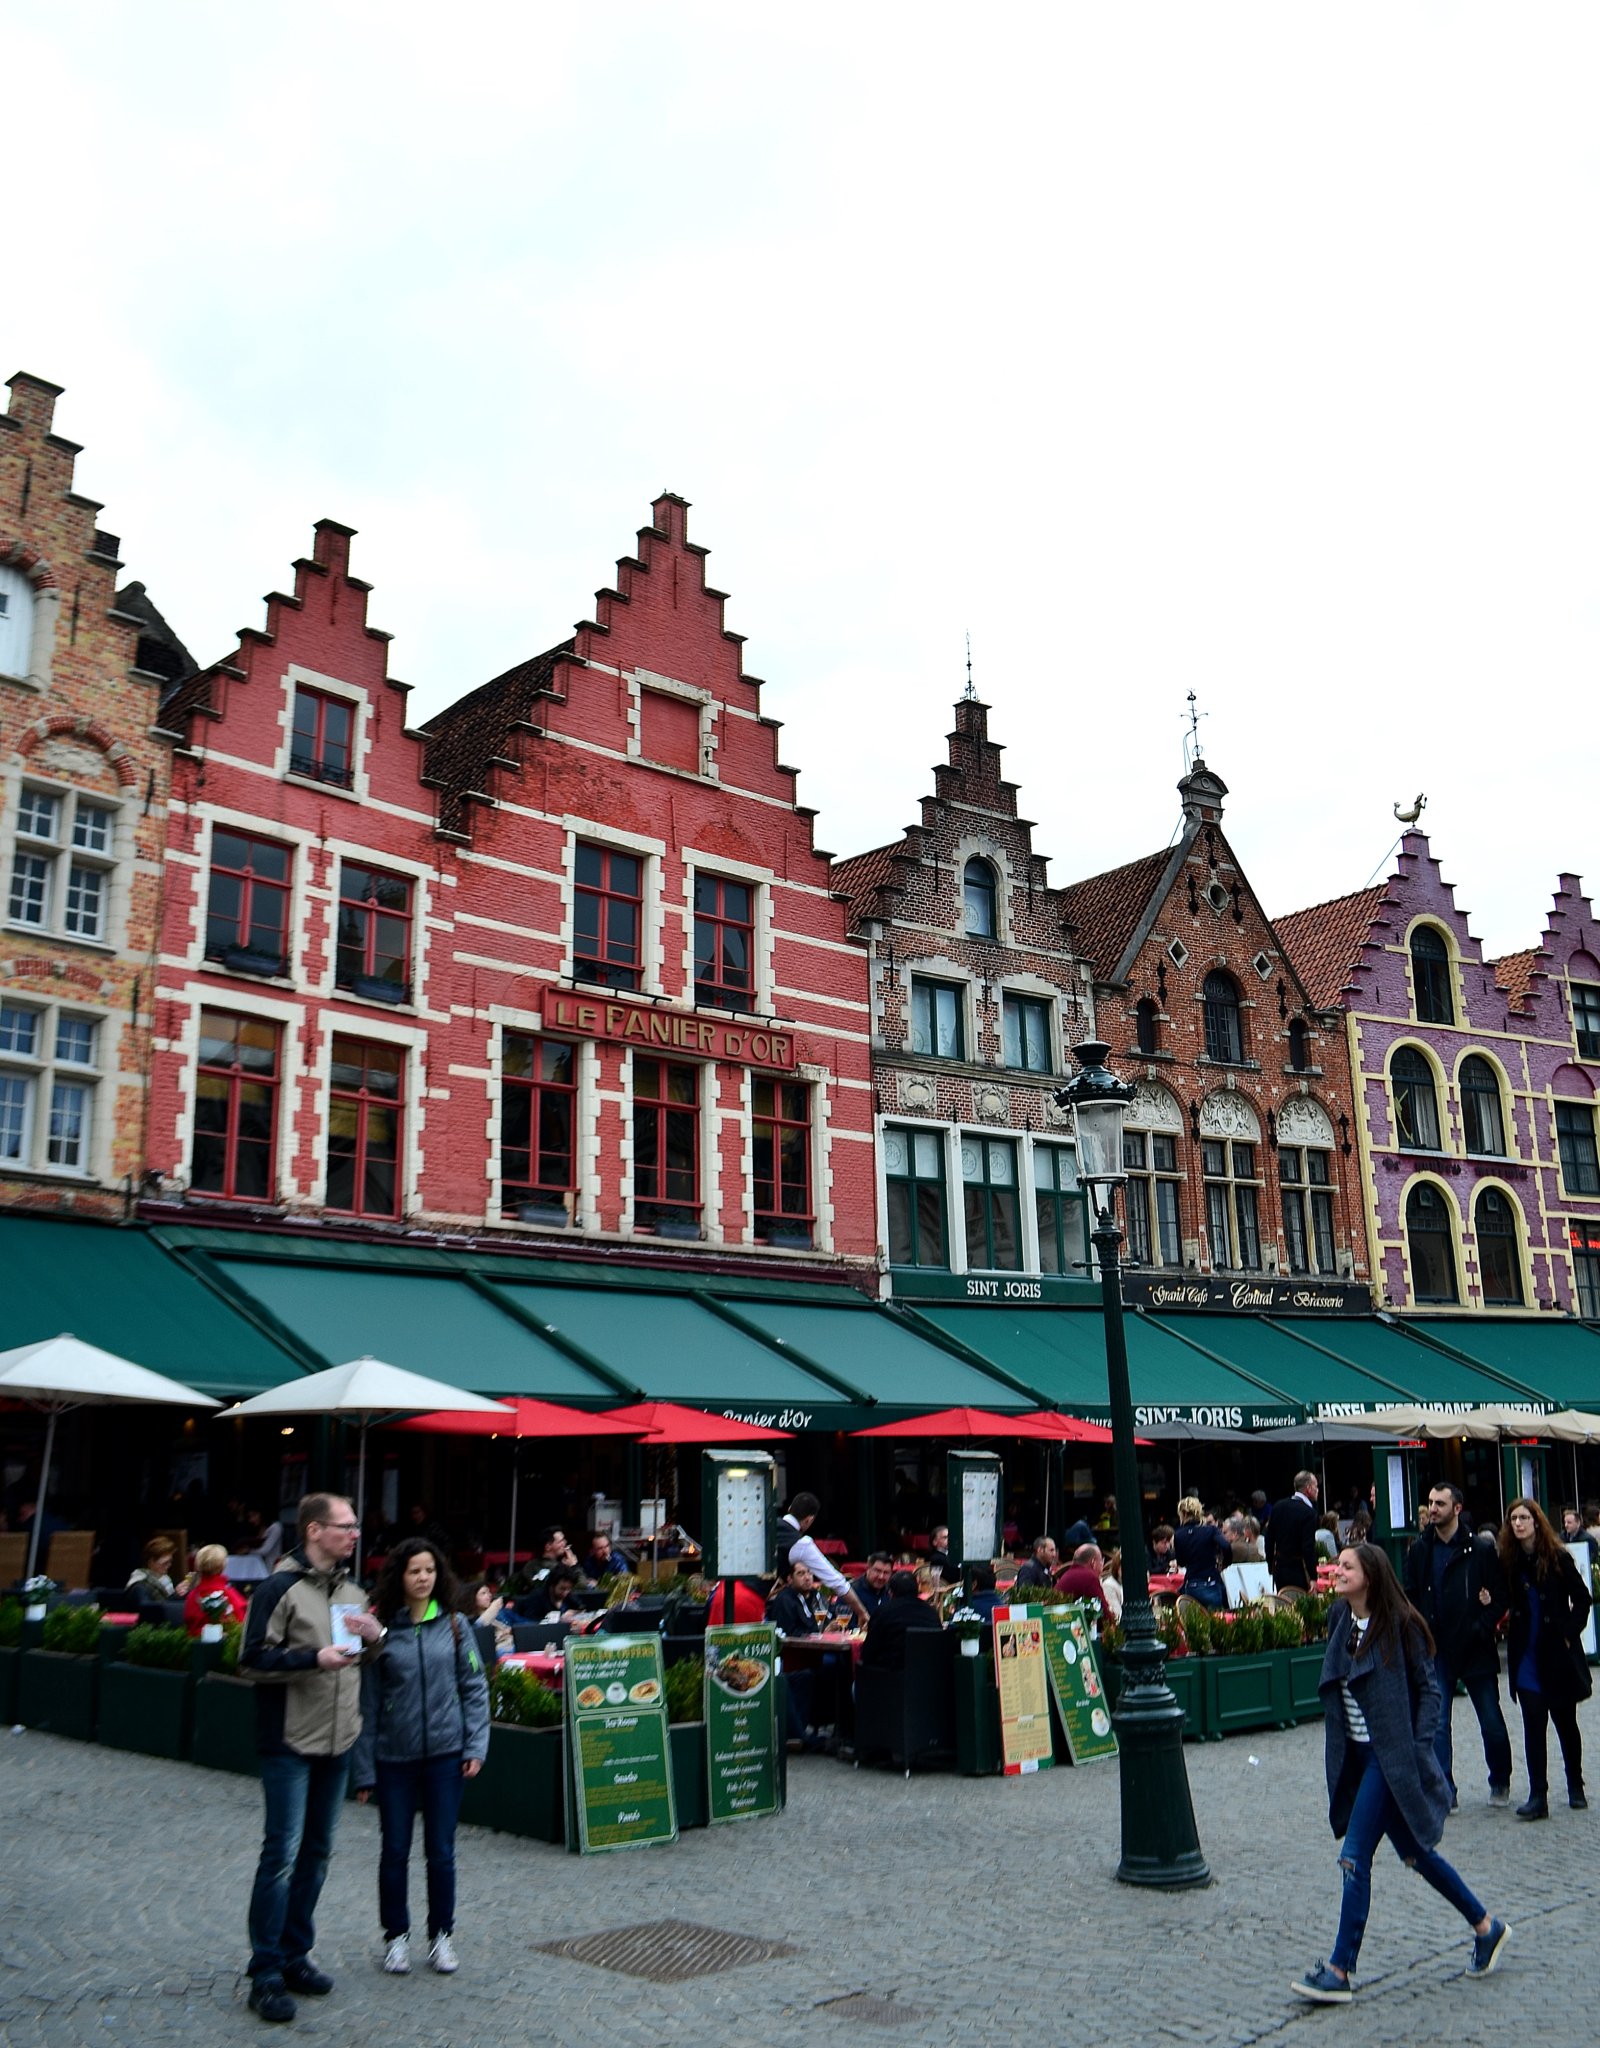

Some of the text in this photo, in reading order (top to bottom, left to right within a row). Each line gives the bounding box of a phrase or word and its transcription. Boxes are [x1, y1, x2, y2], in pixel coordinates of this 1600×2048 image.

[557, 1001, 788, 1064] LE PANIER D'OR
[967, 1280, 1042, 1299] SINT JORIS
[1152, 1284, 1186, 1306] Grand
[1230, 1282, 1274, 1309] Central
[1293, 1291, 1344, 1308] Brasserie
[779, 1408, 813, 1428] d'Or
[1134, 1406, 1181, 1427] SINT
[1188, 1406, 1243, 1428] JORIS
[1252, 1414, 1297, 1428] Brasserie
